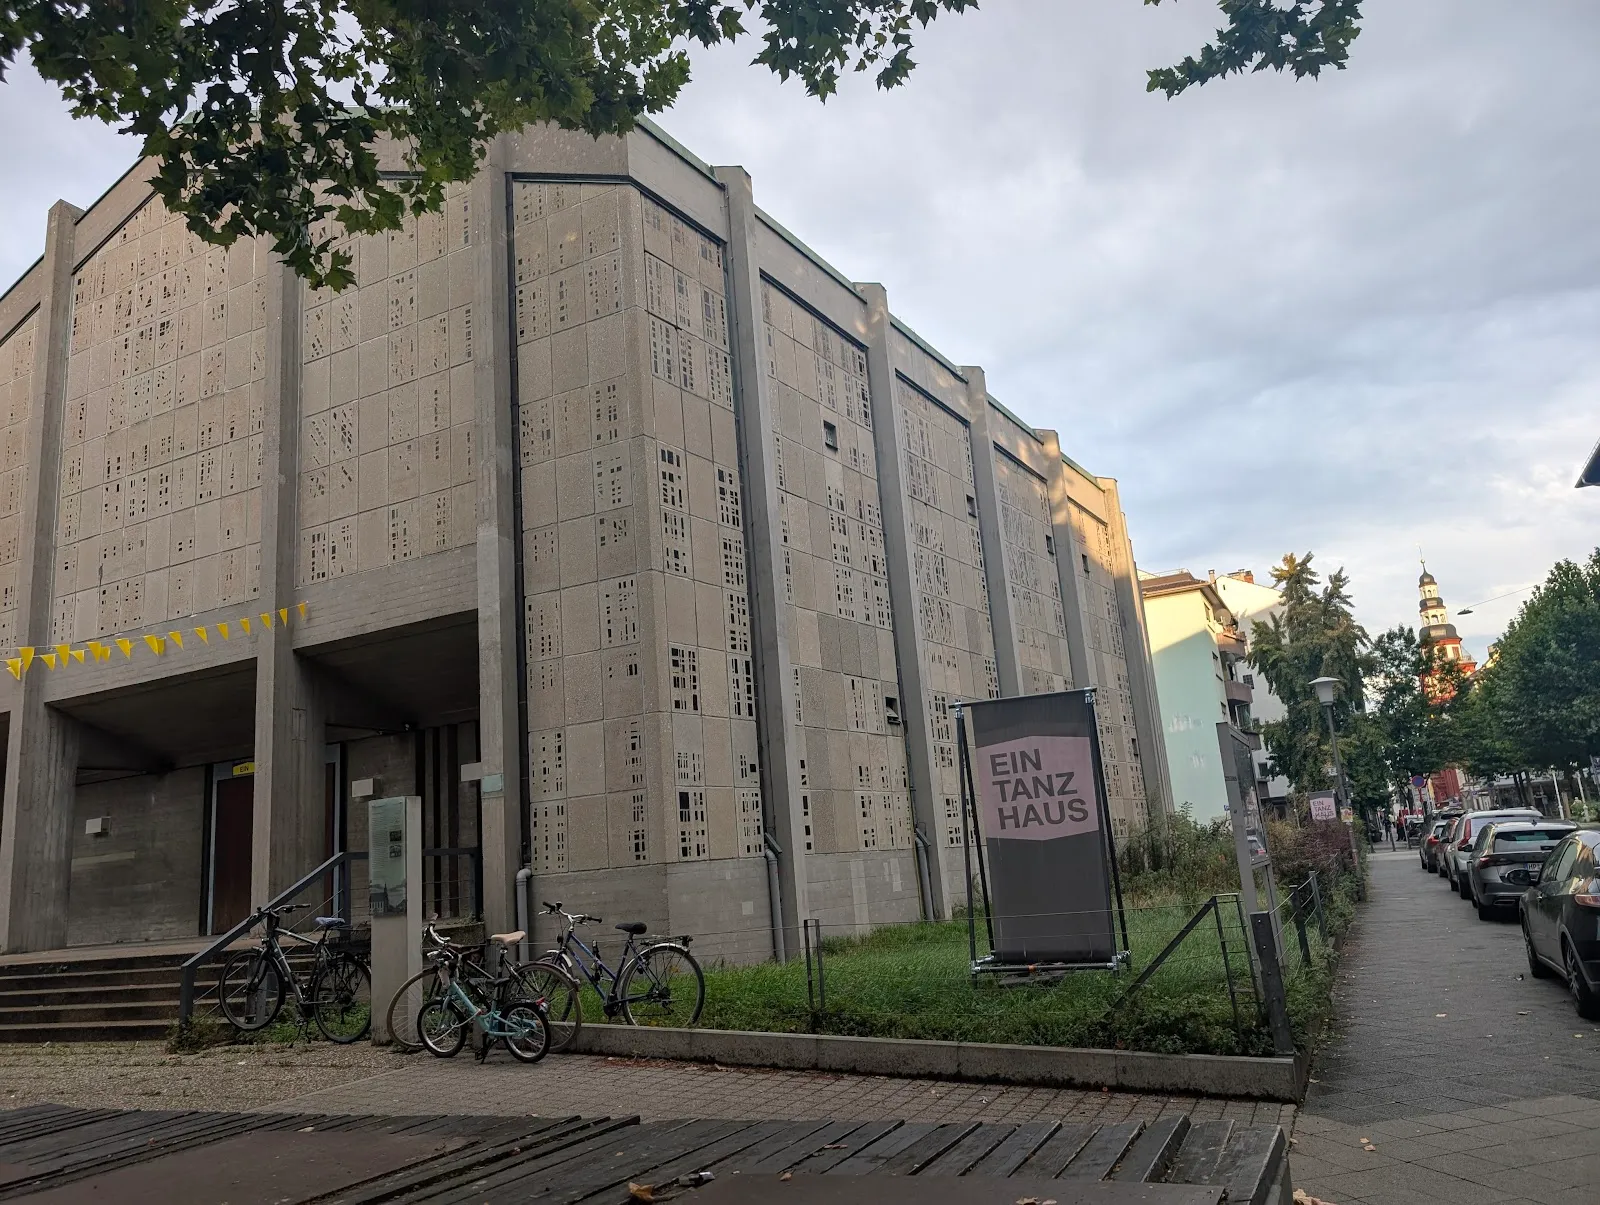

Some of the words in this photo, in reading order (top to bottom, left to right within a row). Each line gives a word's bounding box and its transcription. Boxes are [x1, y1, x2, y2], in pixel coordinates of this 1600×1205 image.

[990, 749, 1042, 776] EIN
[992, 772, 1077, 802] TANZ
[998, 799, 1088, 829] HAUS
